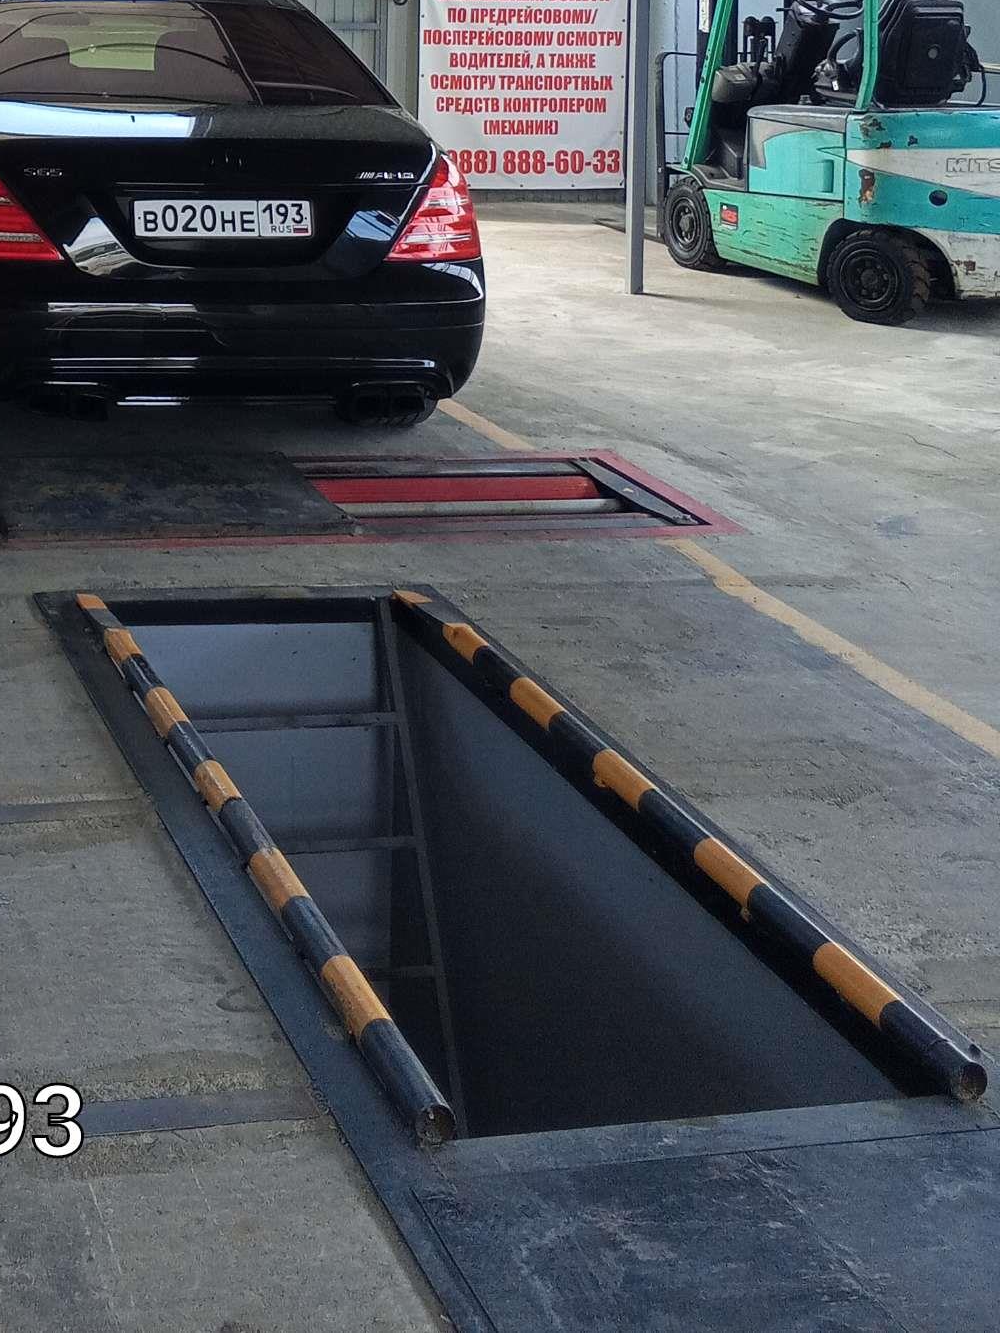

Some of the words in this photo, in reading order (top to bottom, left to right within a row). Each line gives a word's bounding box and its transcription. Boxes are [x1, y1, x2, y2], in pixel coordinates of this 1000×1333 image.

[447, 7, 467, 24] ПО
[470, 6, 598, 26] ПРЕДРЕЙСОВОМУ/
[423, 28, 553, 47] ПОСЛЕРЕЙСОВОМУ
[556, 31, 623, 47] ОСМОТРУ
[449, 50, 534, 71] ВОДИТЕЛЕЙ,
[536, 53, 546, 68] А
[548, 53, 597, 69] ТАКЖЕ
[430, 74, 497, 91] ОСМОТРУ
[500, 75, 613, 91] ТРАНСПОРТНЫХ
[436, 97, 500, 114] СРЕДСТВ
[503, 97, 607, 114] КОНТРОЛЕРОМ
[483, 120, 559, 135] (МЕХАНИК)
[503, 149, 621, 175] 888-60-33
[142, 204, 256, 233] В020НЕ
[262, 203, 304, 225] 193
[270, 225, 292, 234] RUS
